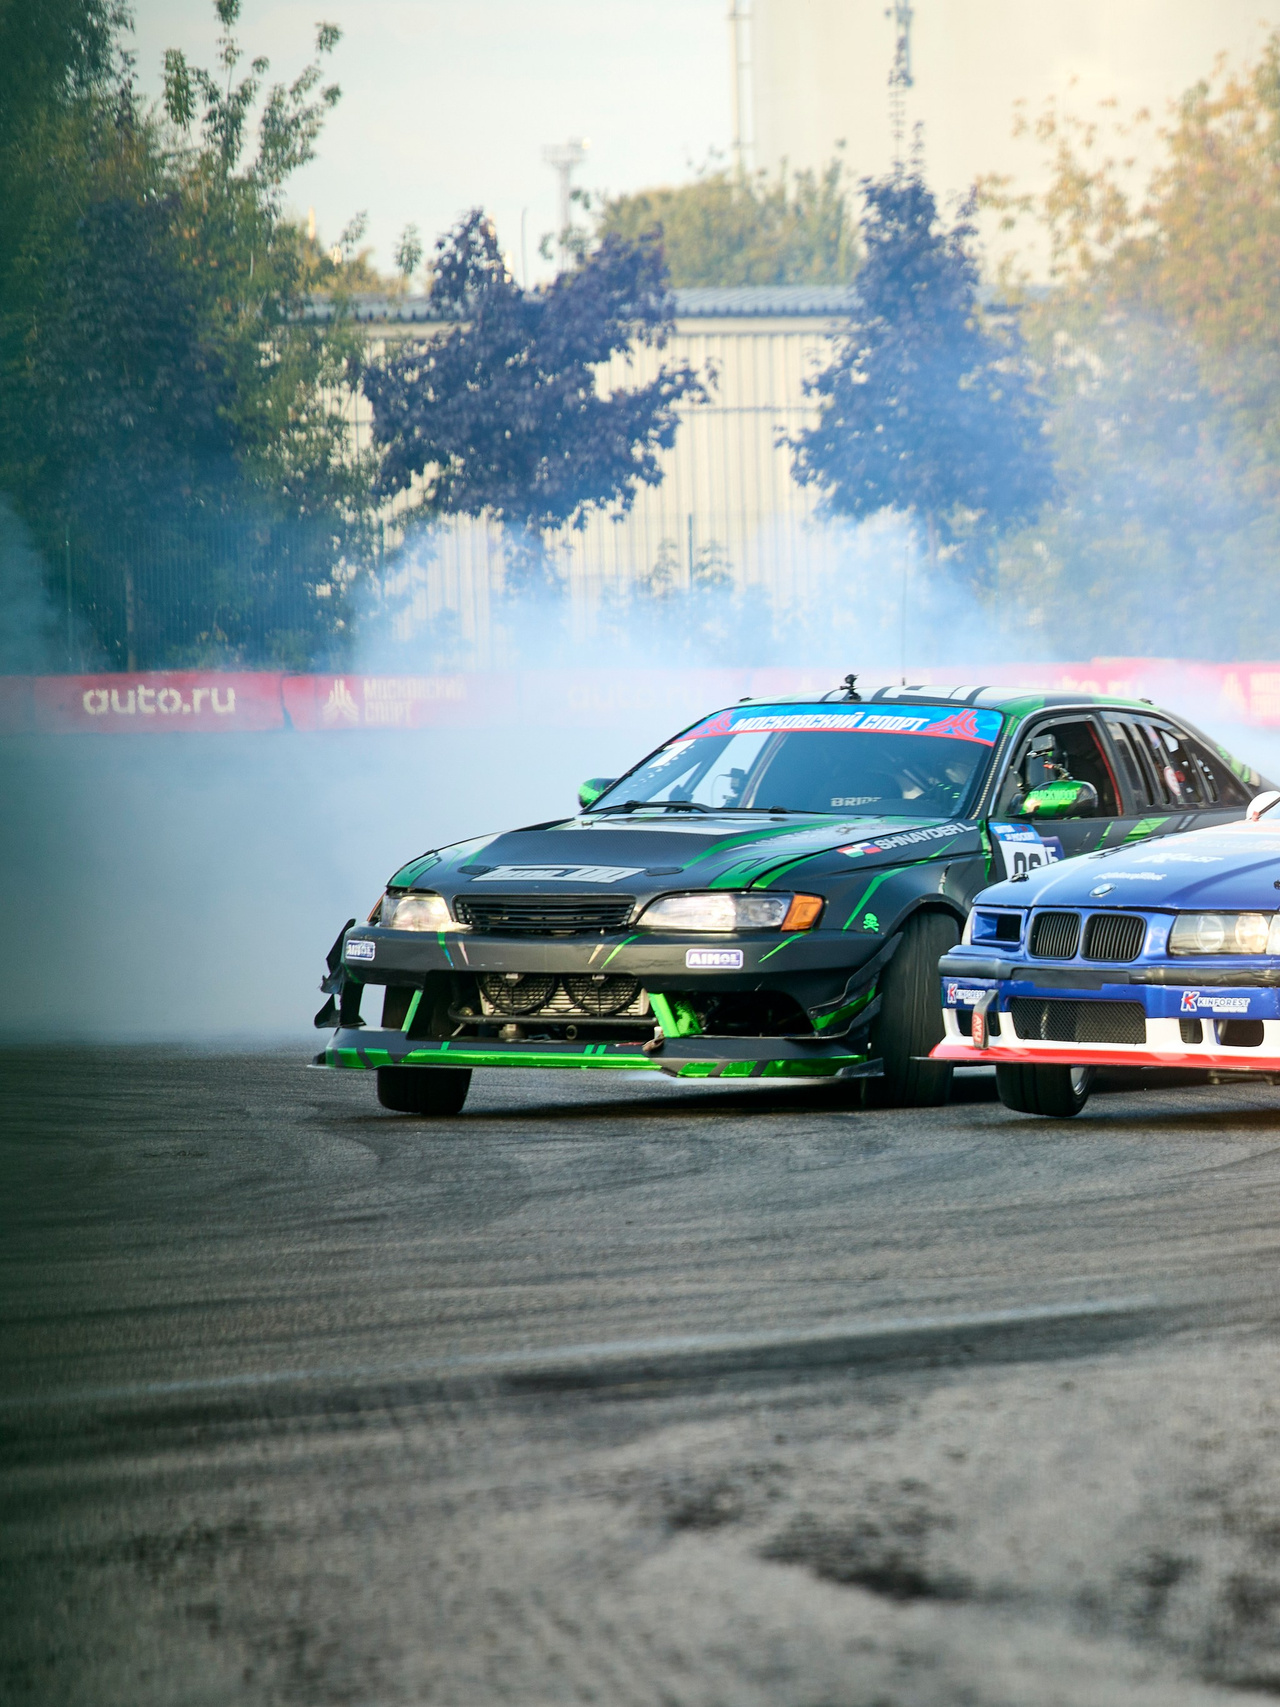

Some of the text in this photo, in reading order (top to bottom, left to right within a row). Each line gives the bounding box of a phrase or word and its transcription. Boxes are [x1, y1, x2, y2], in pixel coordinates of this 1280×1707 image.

[83, 684, 235, 715] auto.ru
[728, 711, 931, 732] МОСКОВСКИЙ СПОРТ
[873, 822, 965, 850] SHNAYDER
[689, 952, 740, 965] AIMOL
[1198, 997, 1250, 1007] KINFOREST
